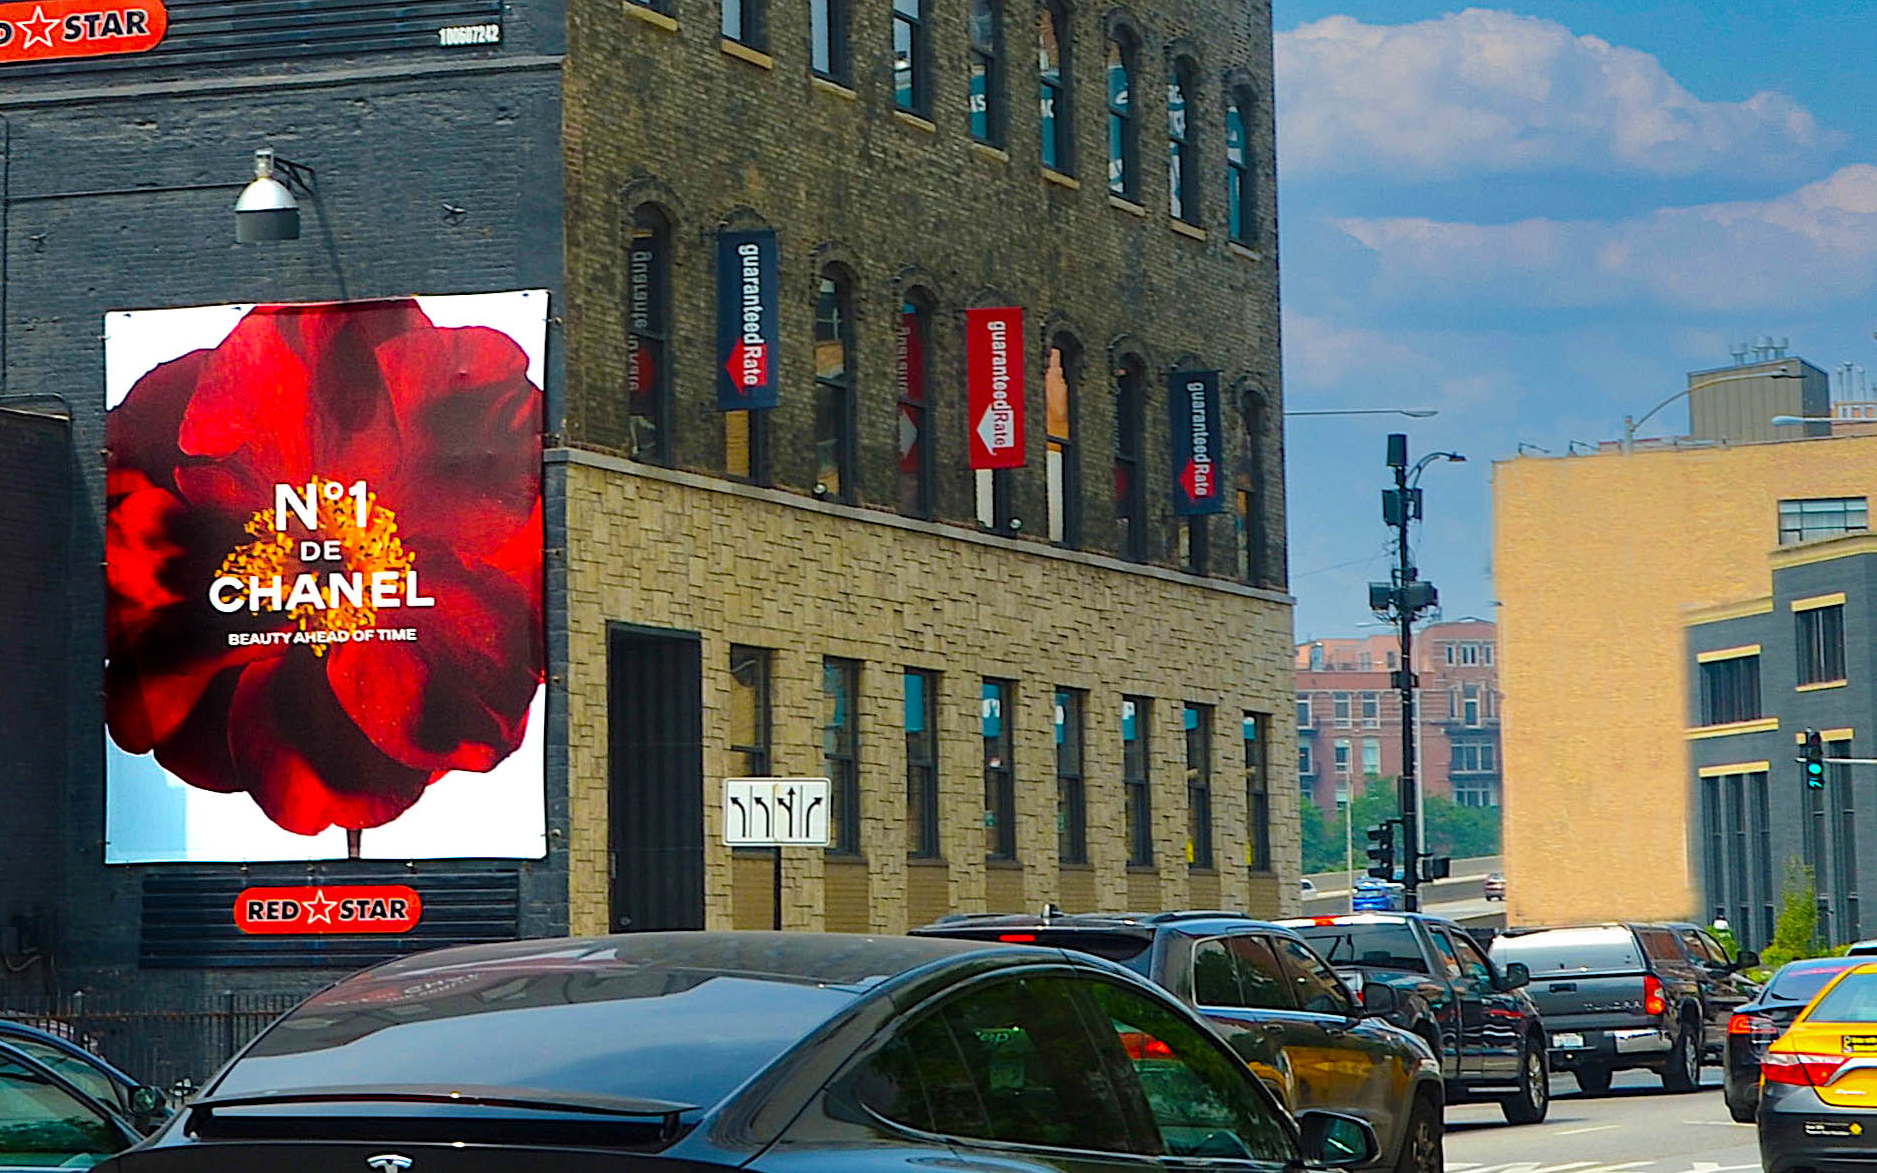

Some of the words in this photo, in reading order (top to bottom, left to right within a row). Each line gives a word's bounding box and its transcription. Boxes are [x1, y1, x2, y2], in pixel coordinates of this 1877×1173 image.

[62, 9, 150, 42] STAR
[300, 540, 342, 562] DE
[208, 569, 435, 613] CHANEL
[228, 632, 293, 646] BEAUTY
[293, 630, 349, 644] AHEAD
[352, 629, 374, 642] OF
[377, 628, 417, 641] TIME
[246, 899, 302, 922] RED
[338, 898, 409, 921] STAR
